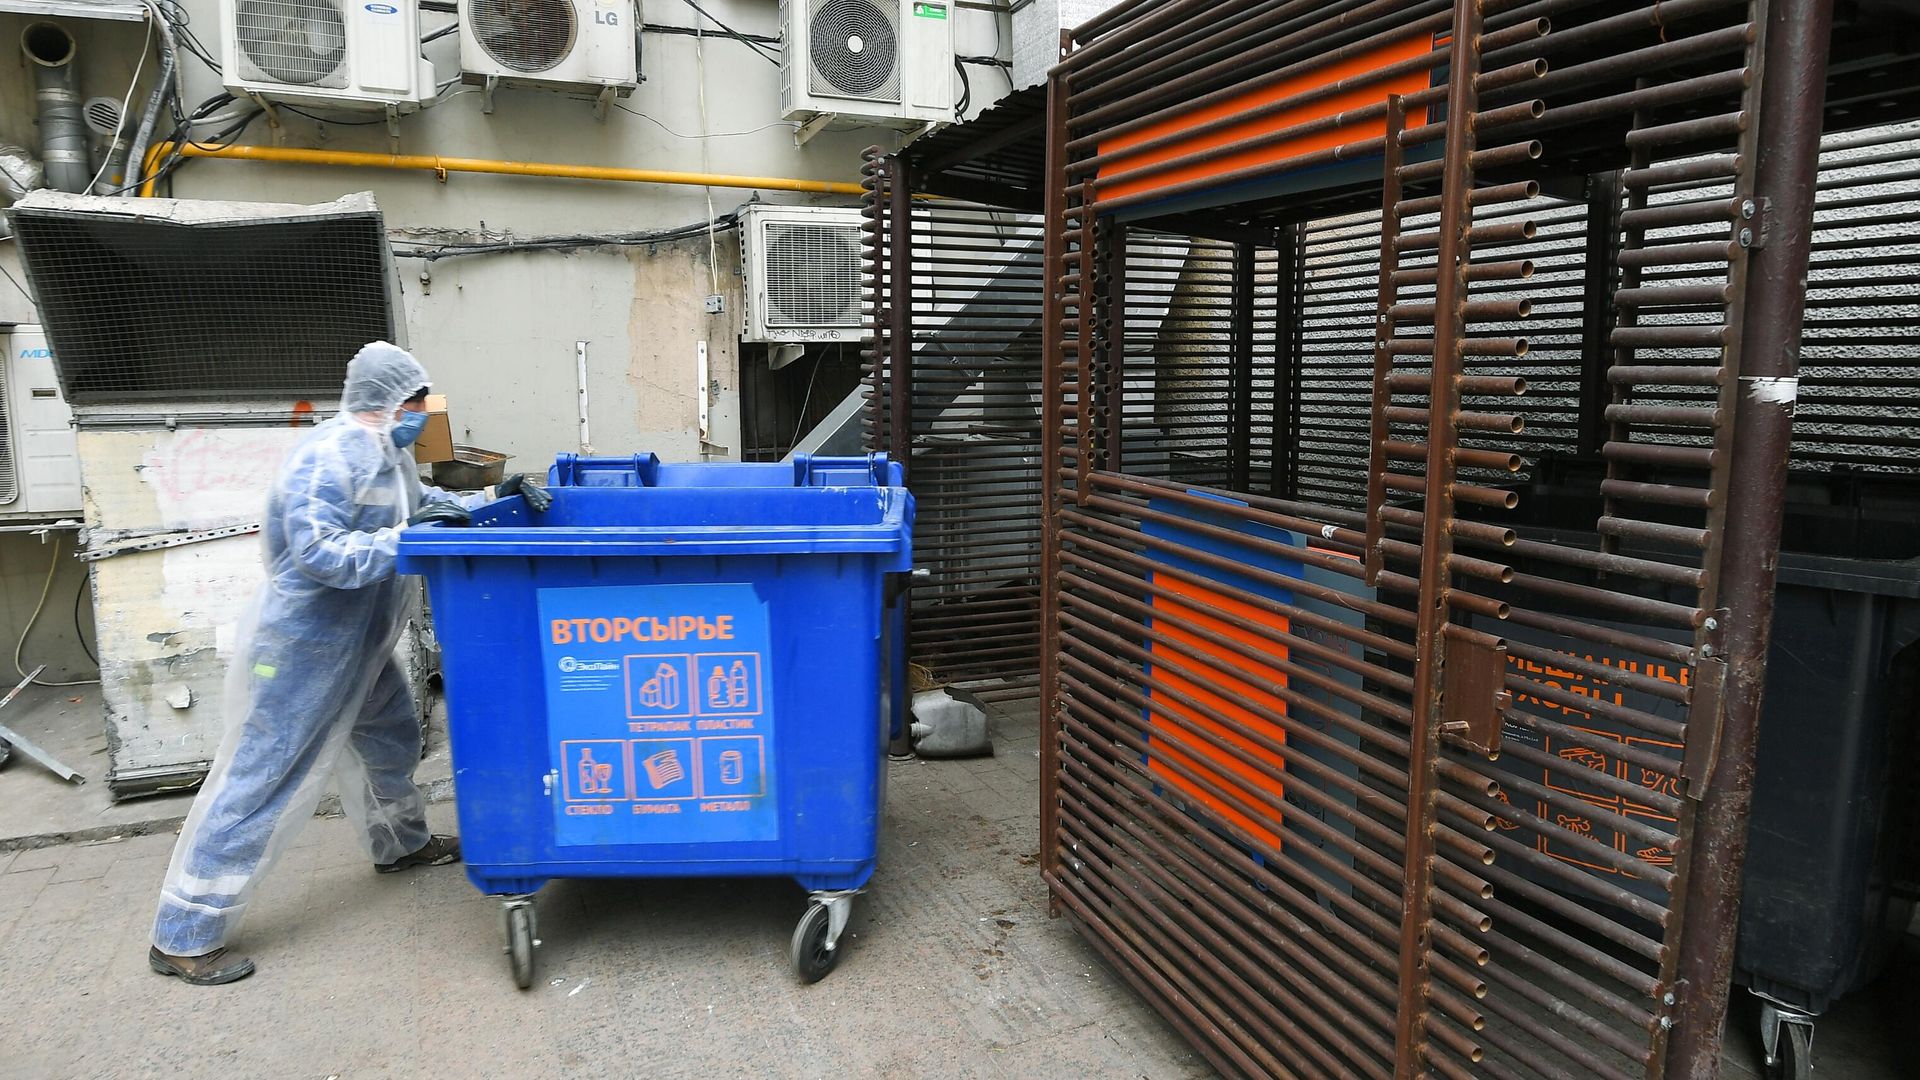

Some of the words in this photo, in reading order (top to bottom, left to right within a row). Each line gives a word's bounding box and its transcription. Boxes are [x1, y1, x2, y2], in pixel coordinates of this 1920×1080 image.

[595, 10, 618, 26] LG
[551, 615, 735, 645] ВТОРСЫРЬЕ
[628, 721, 692, 733] ТЕТРАПАК
[696, 718, 754, 730] ПЛАСТИК
[565, 804, 614, 816] СТЕКЛО
[632, 803, 681, 815] БУМАГА
[700, 801, 751, 812] МЕТАЛЛ
